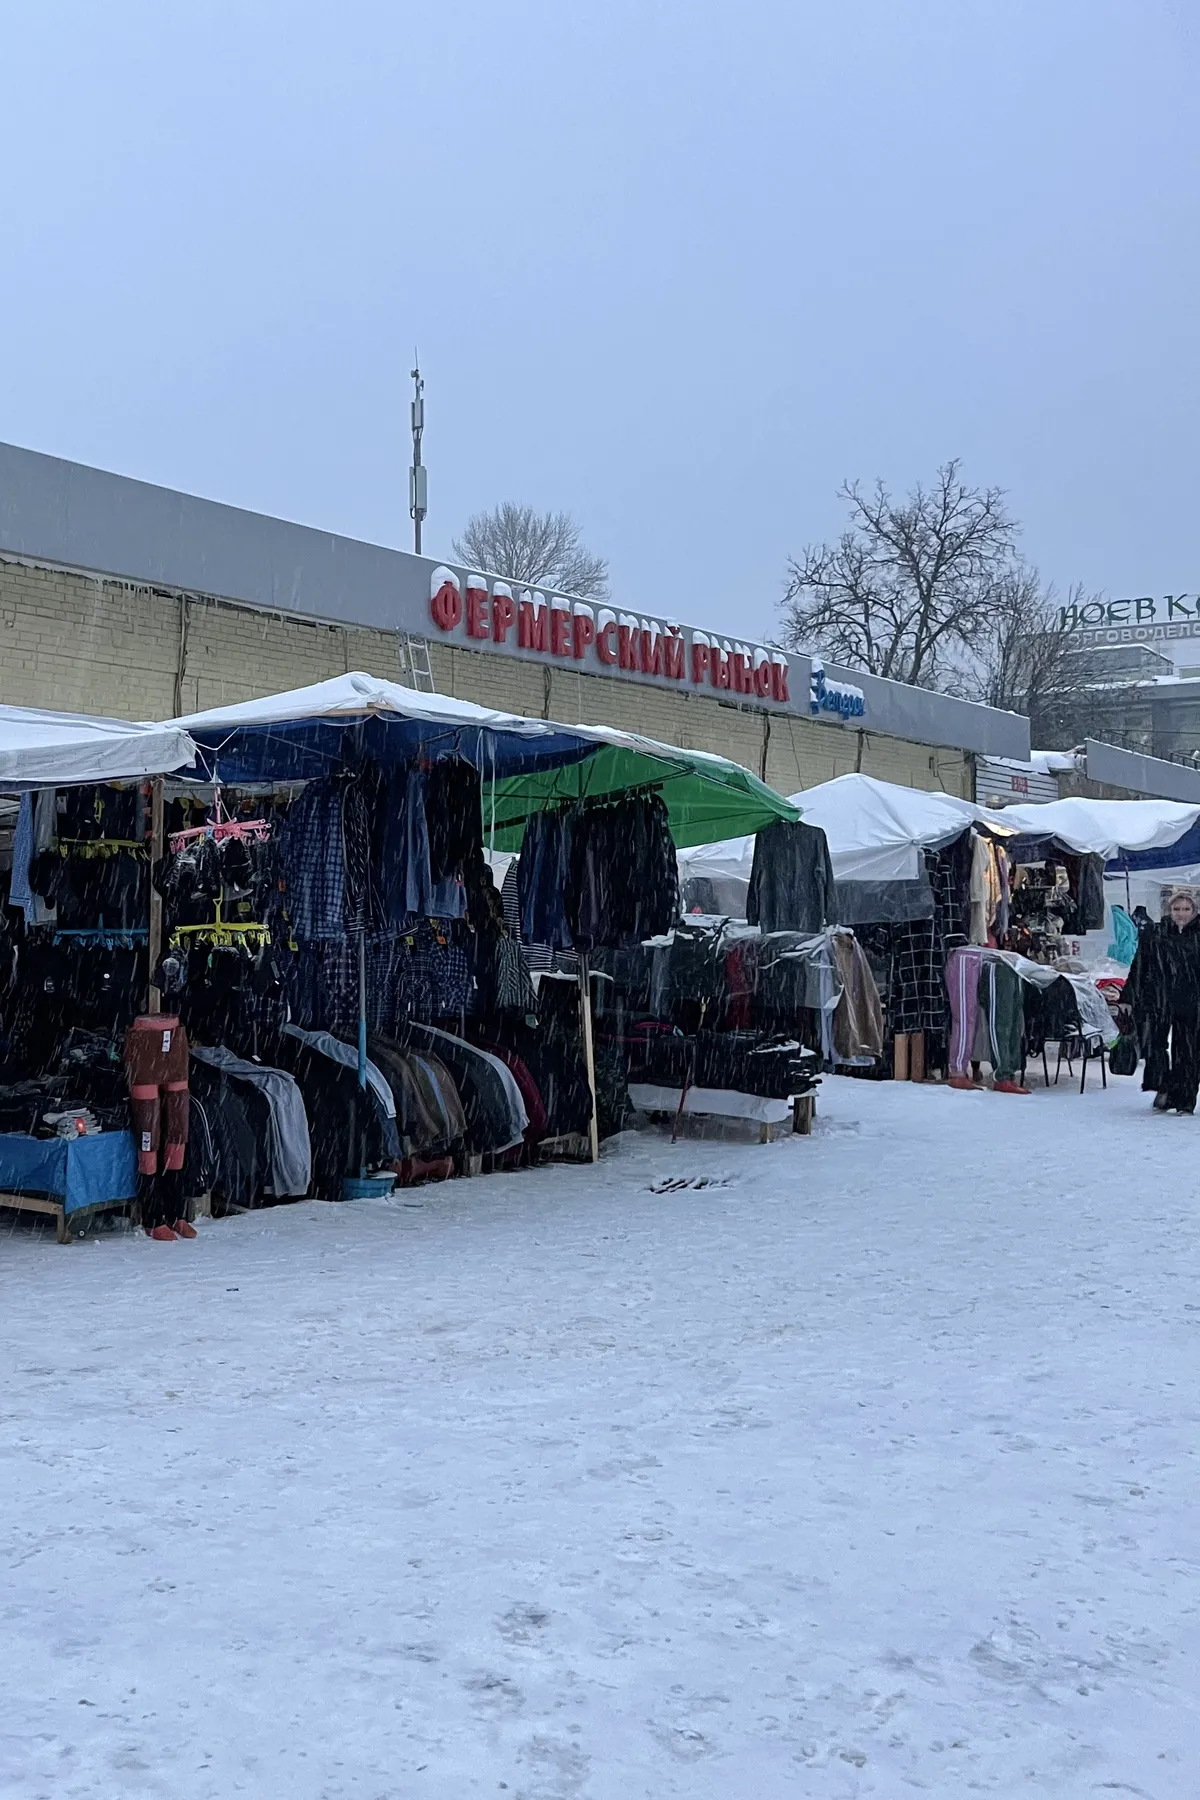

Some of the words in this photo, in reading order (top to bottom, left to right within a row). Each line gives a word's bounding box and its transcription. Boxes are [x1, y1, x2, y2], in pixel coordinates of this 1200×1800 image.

[430, 576, 686, 679] ФЕРМЕРСКИЙ
[691, 640, 791, 702] РЫНОК
[1162, 593, 1200, 617] К
